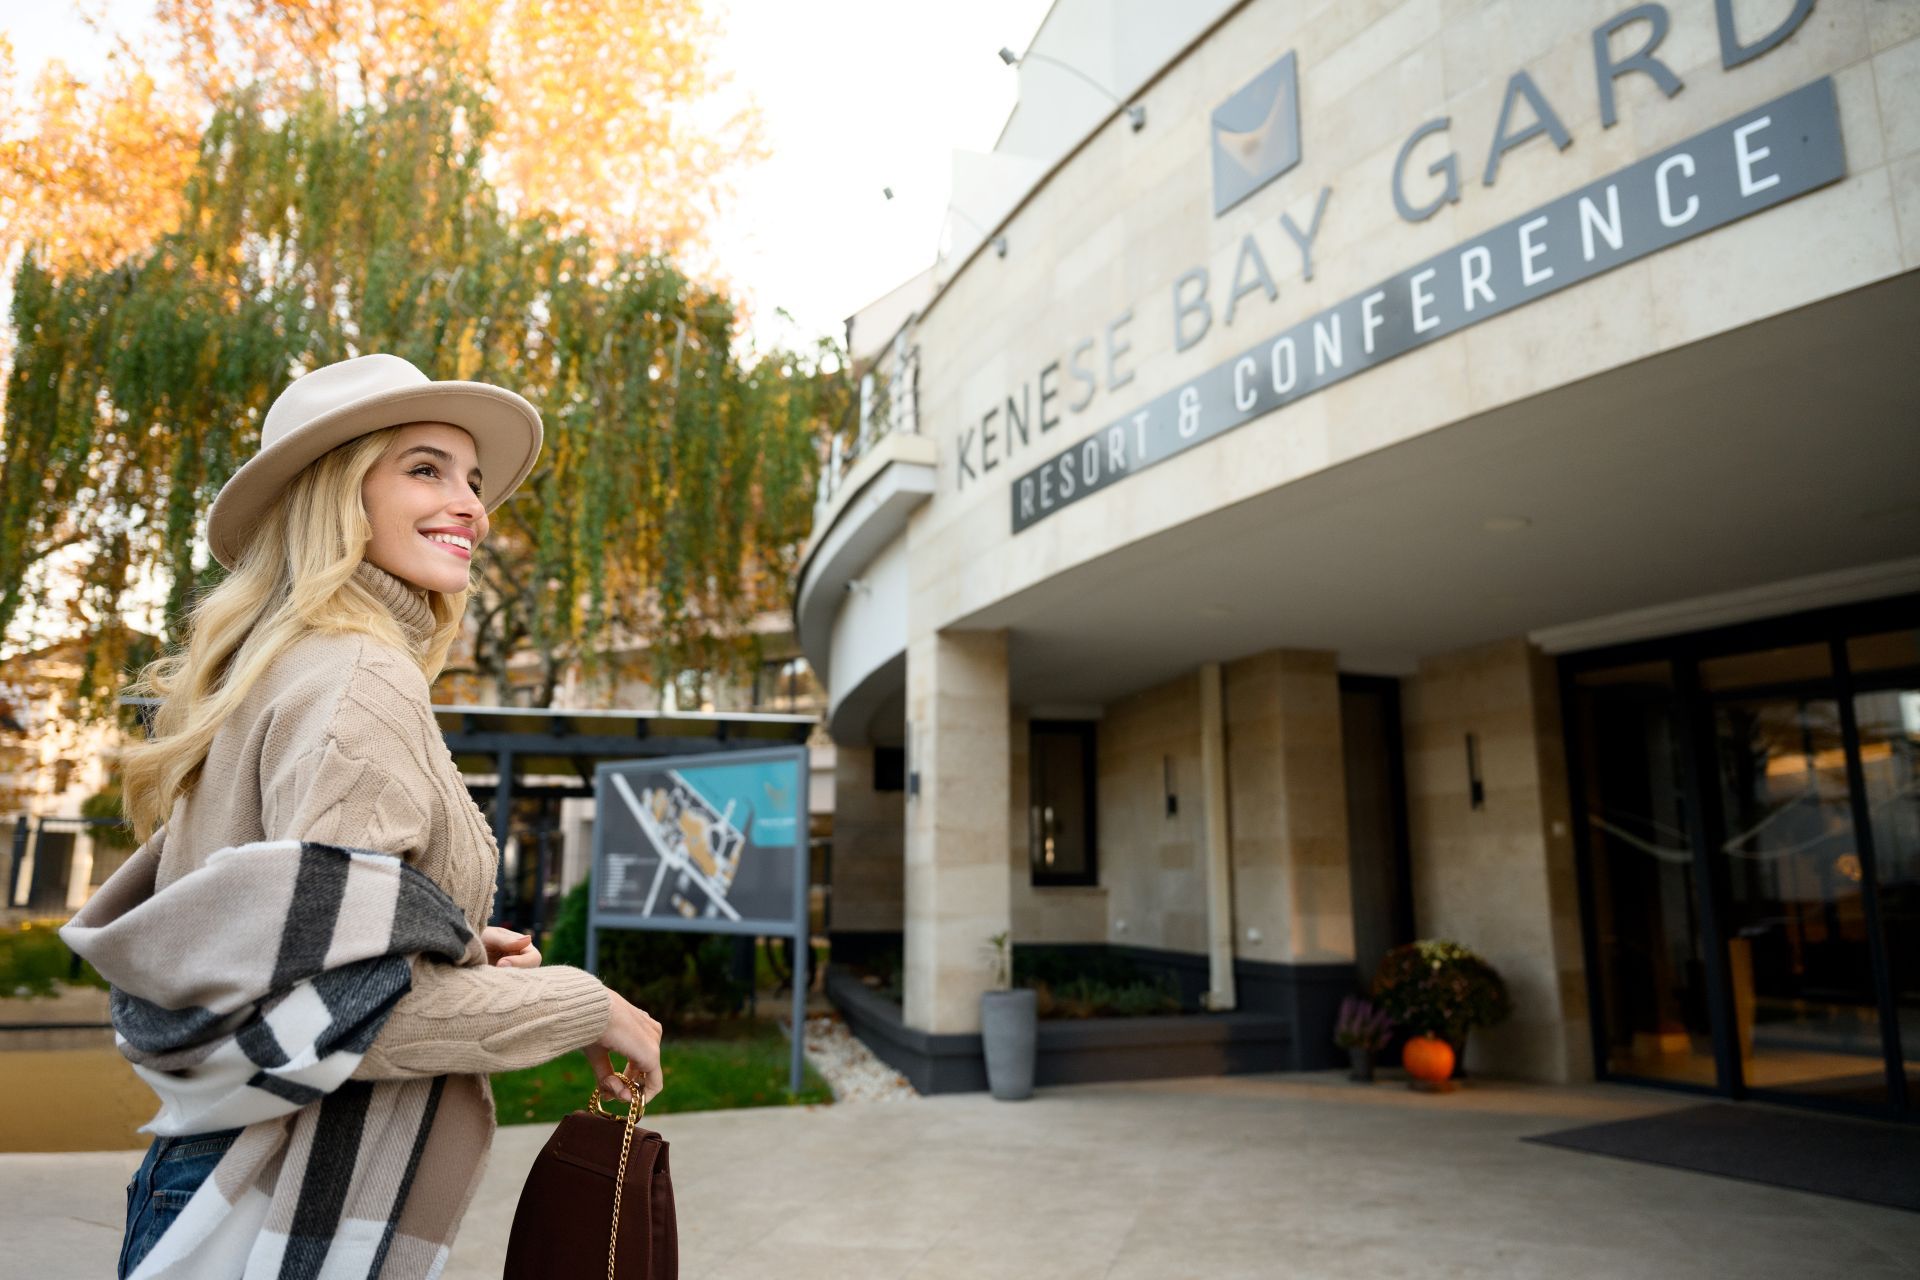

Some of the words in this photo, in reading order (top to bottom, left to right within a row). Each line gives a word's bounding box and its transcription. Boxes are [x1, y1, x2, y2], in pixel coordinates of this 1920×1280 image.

[956, 311, 1136, 491] KENESE
[1171, 186, 1331, 354] BAY
[1019, 411, 1151, 521] RESORT
[1178, 385, 1201, 438] &
[1233, 115, 1780, 412] CONFERENCE
